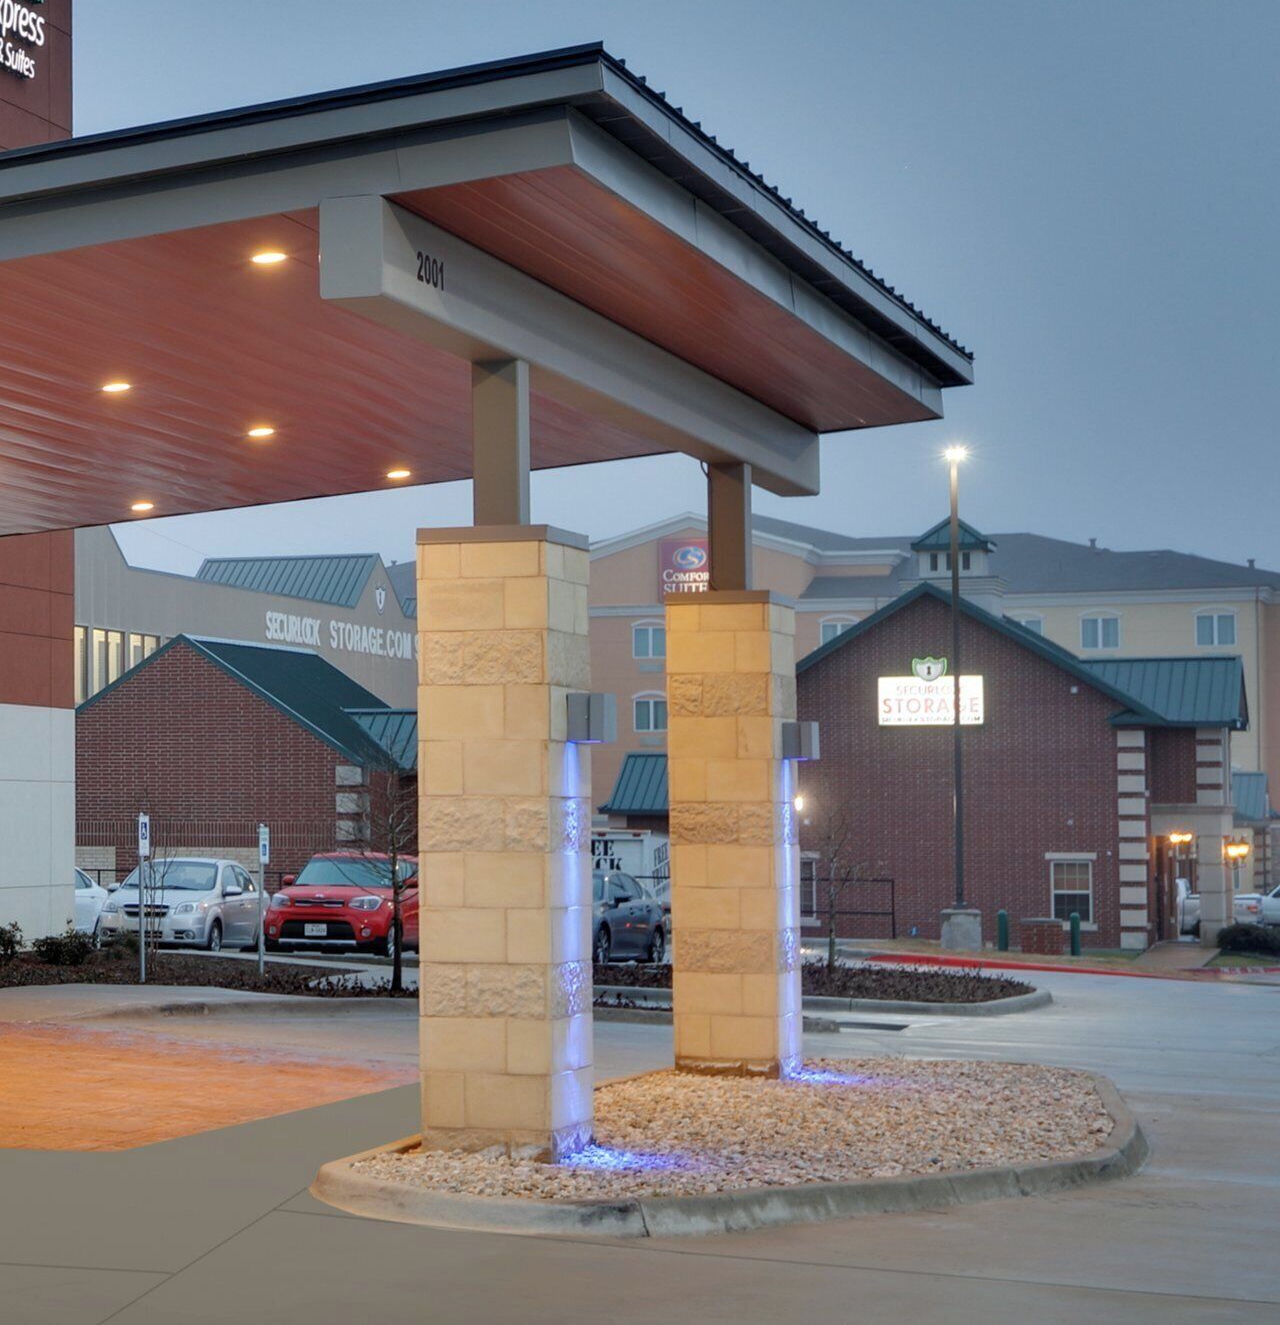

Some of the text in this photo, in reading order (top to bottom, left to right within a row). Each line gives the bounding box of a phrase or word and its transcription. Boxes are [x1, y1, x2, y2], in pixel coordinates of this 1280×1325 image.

[4, 44, 36, 80] Suites
[417, 251, 445, 291] 2001
[662, 569, 710, 582] COMFOR
[663, 582, 709, 595] SUITE
[265, 610, 321, 646] SECURLOCK
[329, 619, 412, 660] STORAGE.COM
